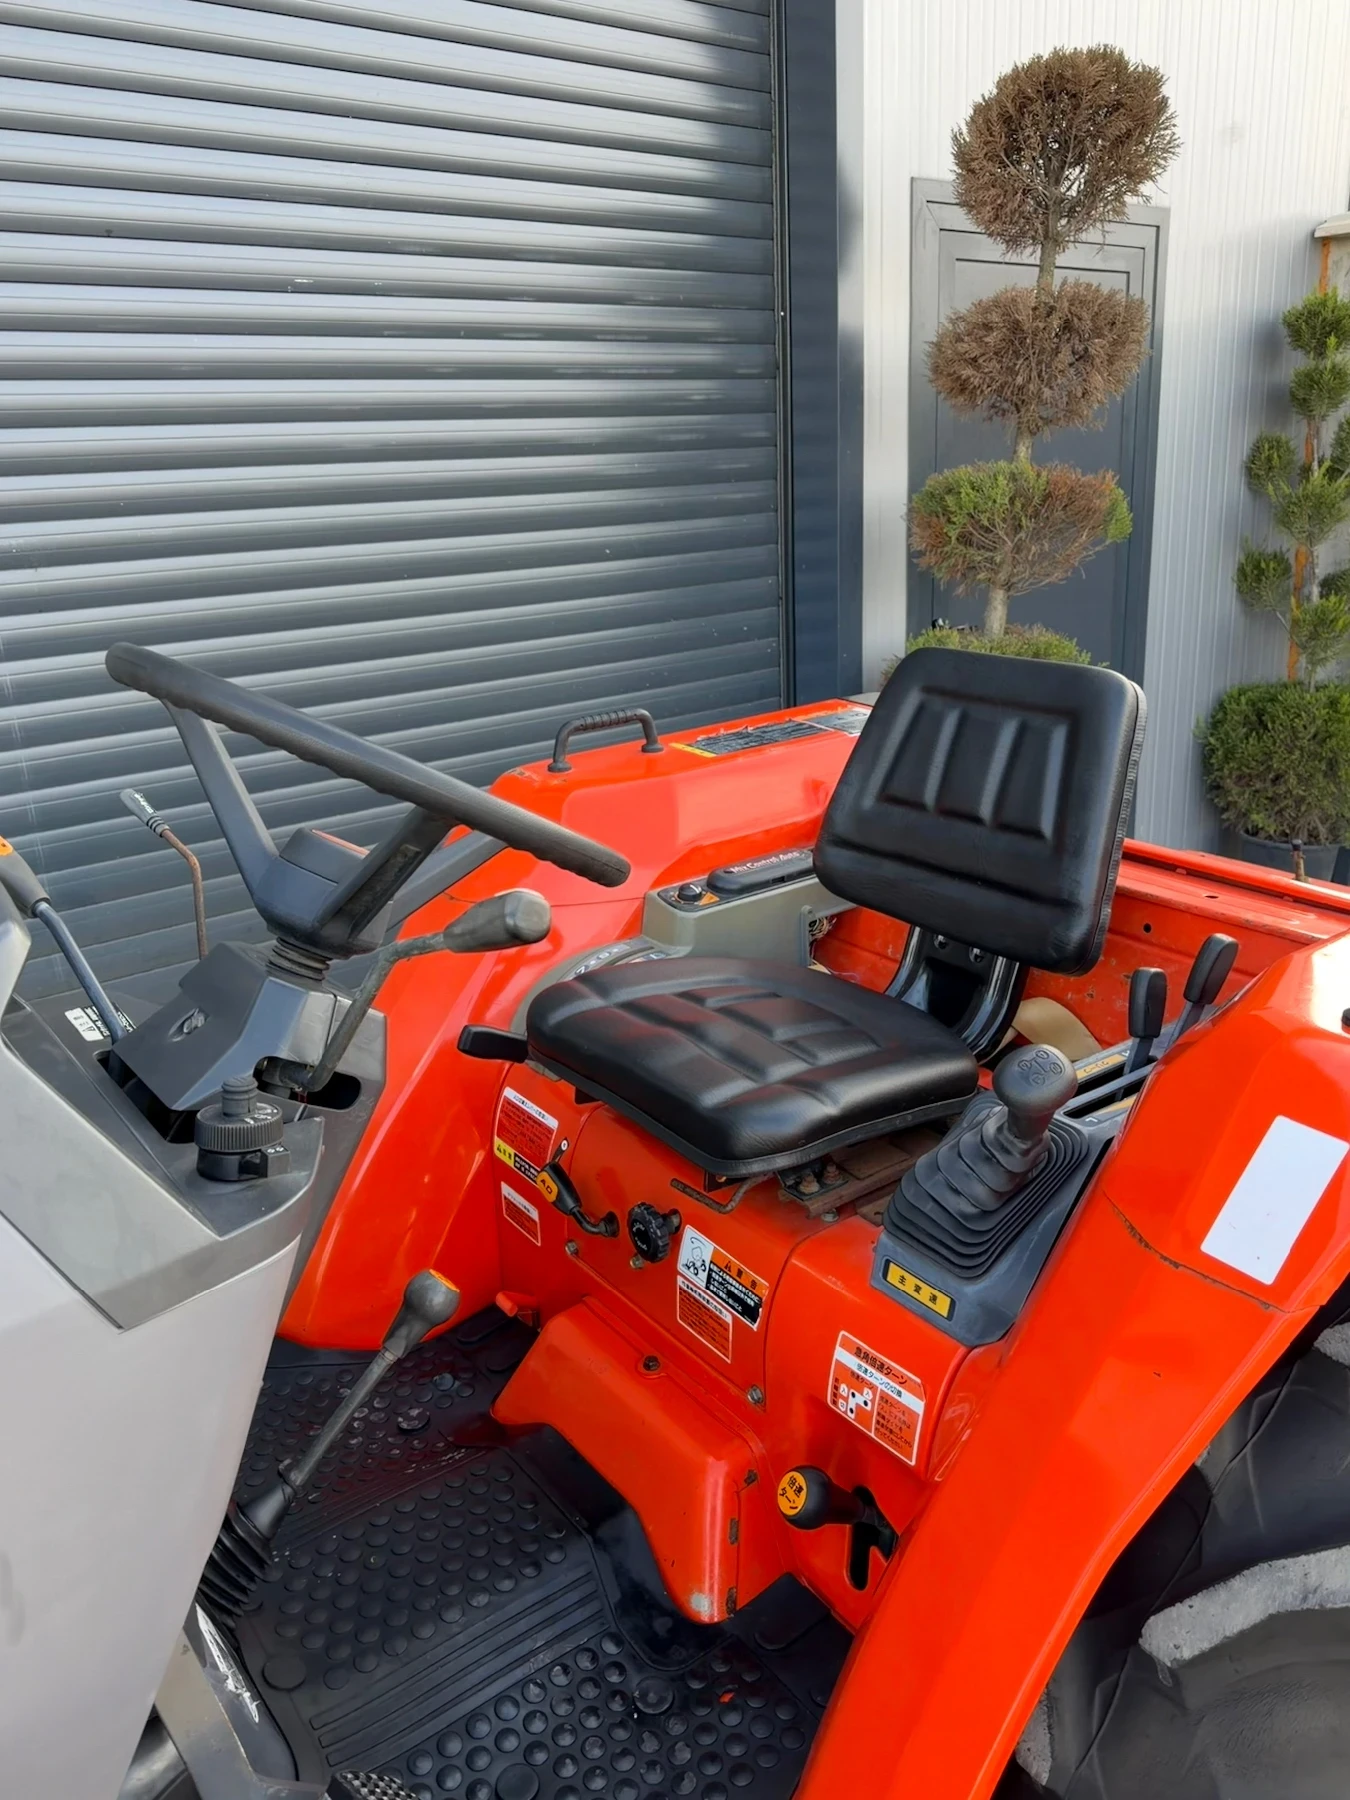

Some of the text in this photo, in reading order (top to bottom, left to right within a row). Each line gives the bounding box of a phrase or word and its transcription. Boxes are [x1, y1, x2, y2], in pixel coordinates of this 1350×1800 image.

[748, 856, 778, 871] Control
[897, 1274, 938, 1306] 主変速
[854, 1346, 908, 1385] 急角倍速ターン
[787, 1475, 805, 1498] 倍速
